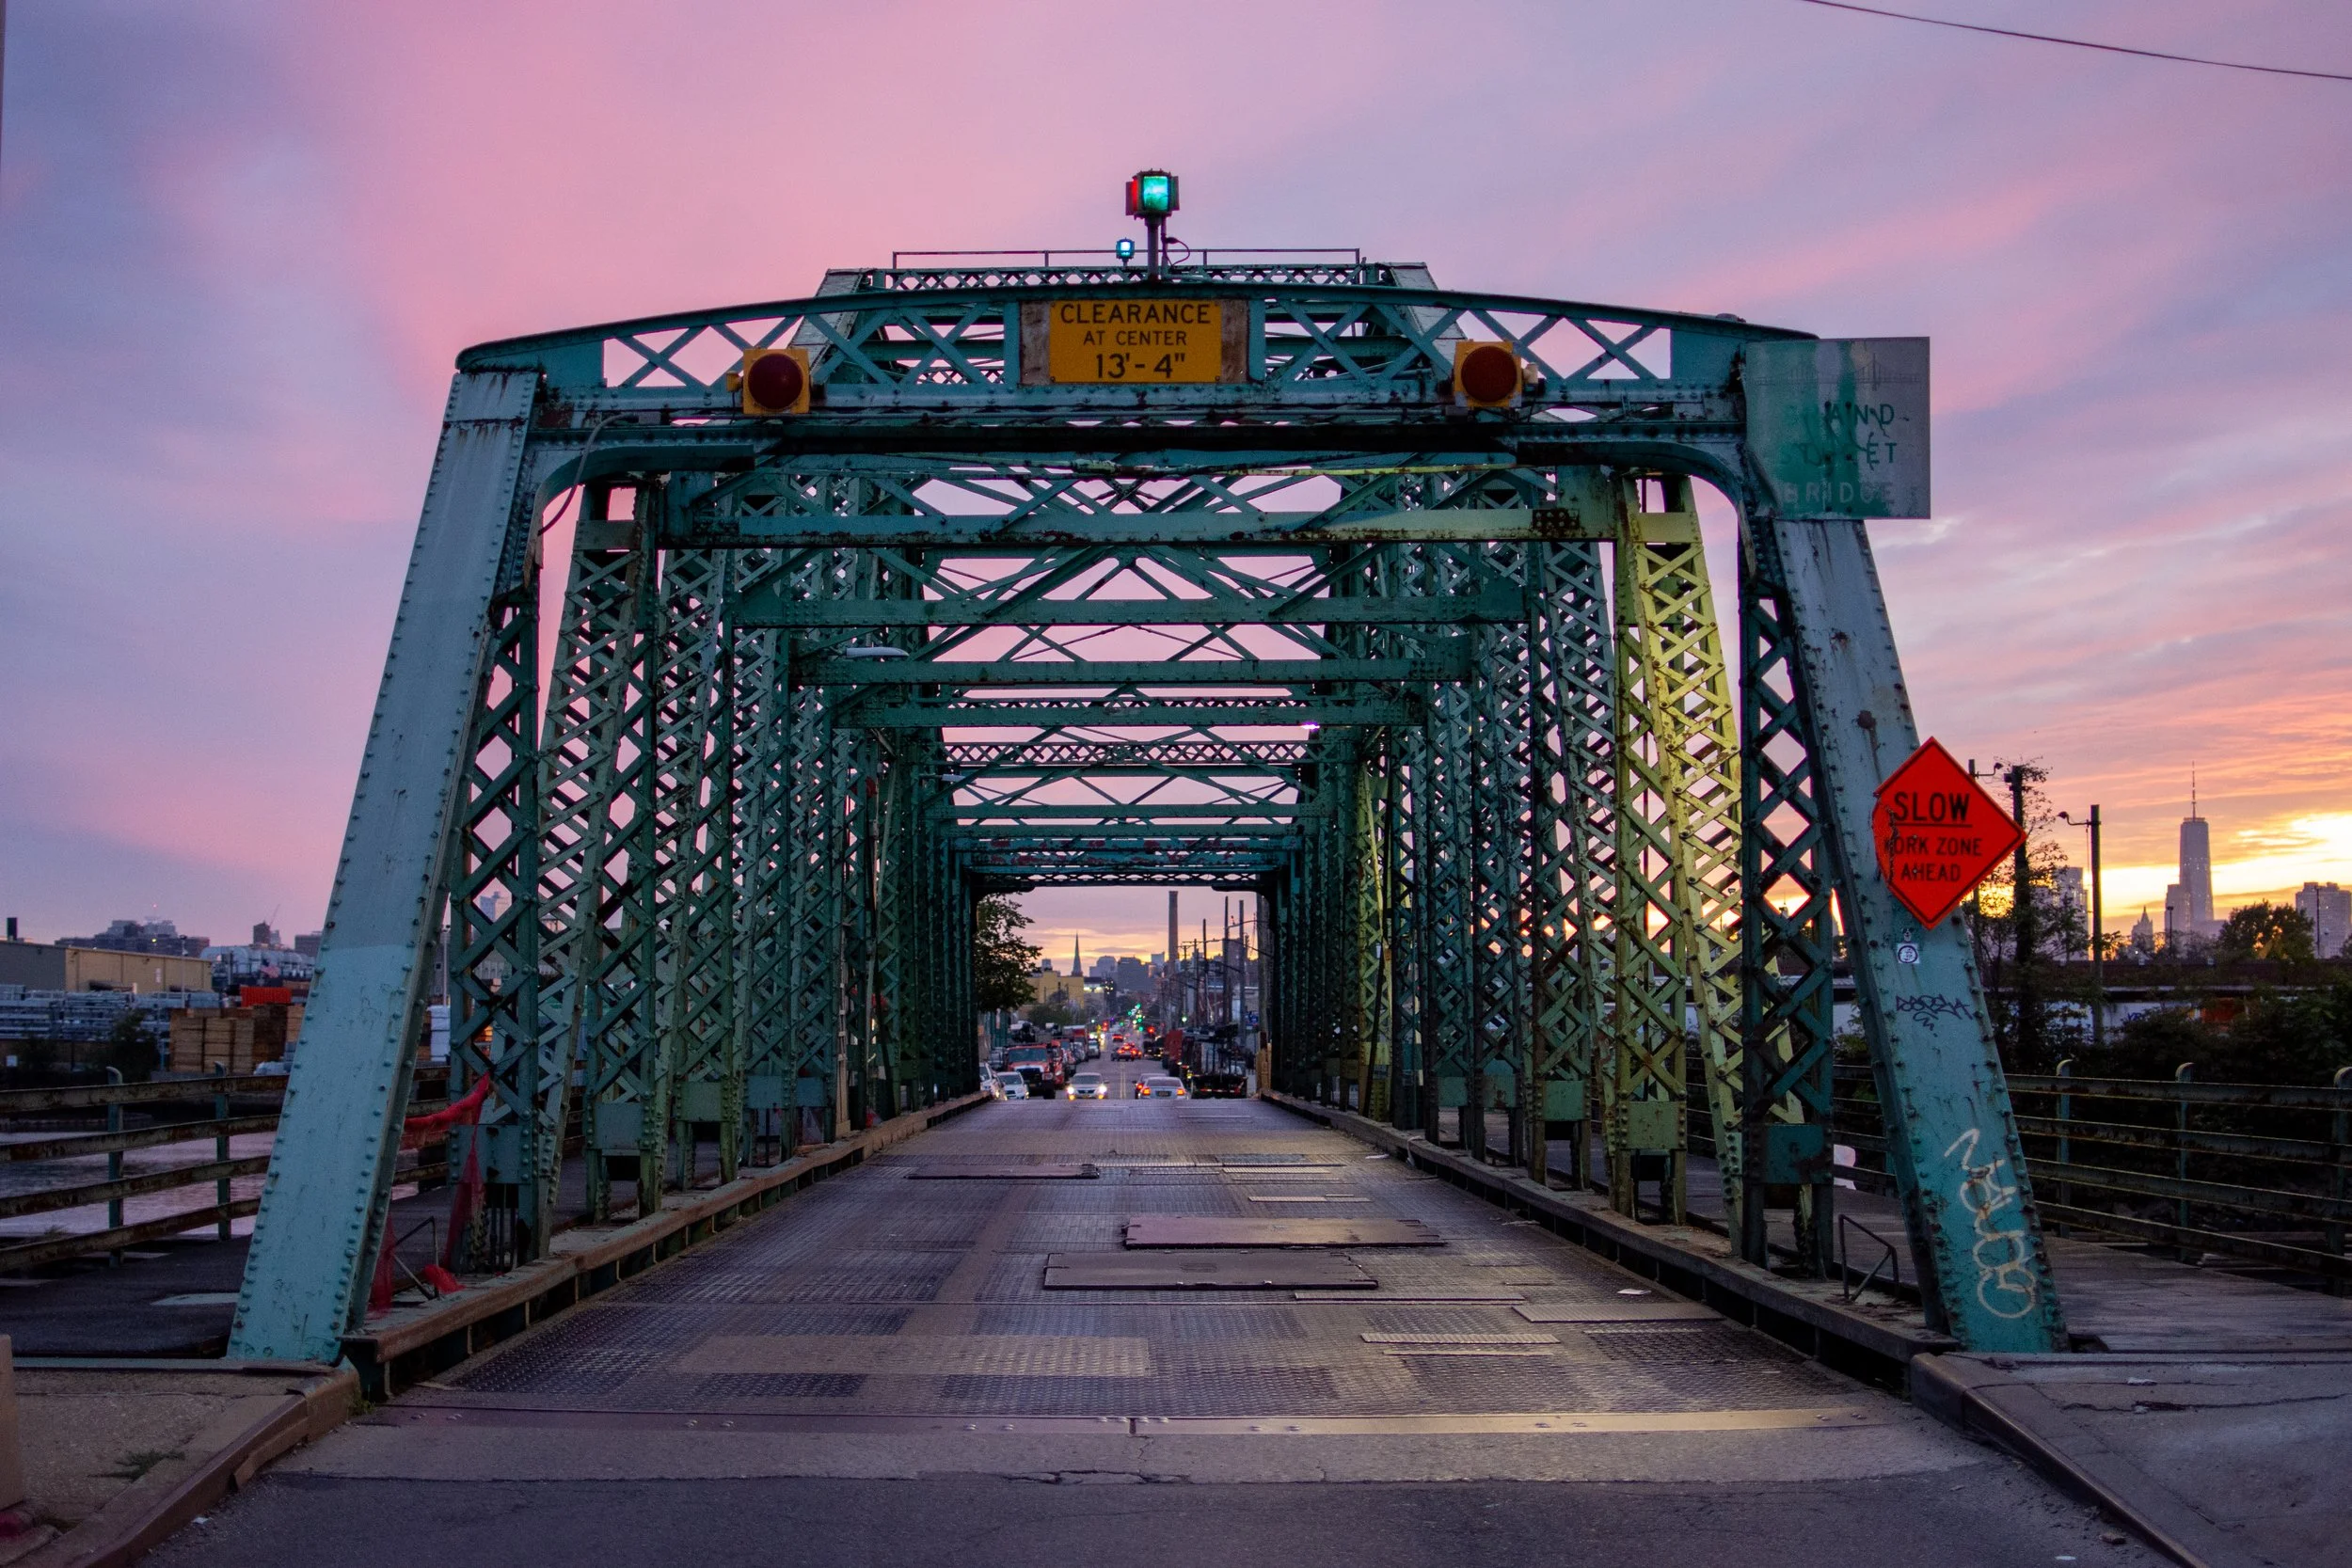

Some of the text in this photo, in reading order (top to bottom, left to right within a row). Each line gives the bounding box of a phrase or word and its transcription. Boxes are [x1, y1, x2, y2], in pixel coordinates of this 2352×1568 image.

[1060, 303, 1211, 325] CLEARANCE
[1083, 330, 1187, 346] AT CENTER
[1891, 791, 1970, 822] SLOW
[1936, 837, 1982, 856] ZONE
[1901, 863, 1961, 881] AHEAD
